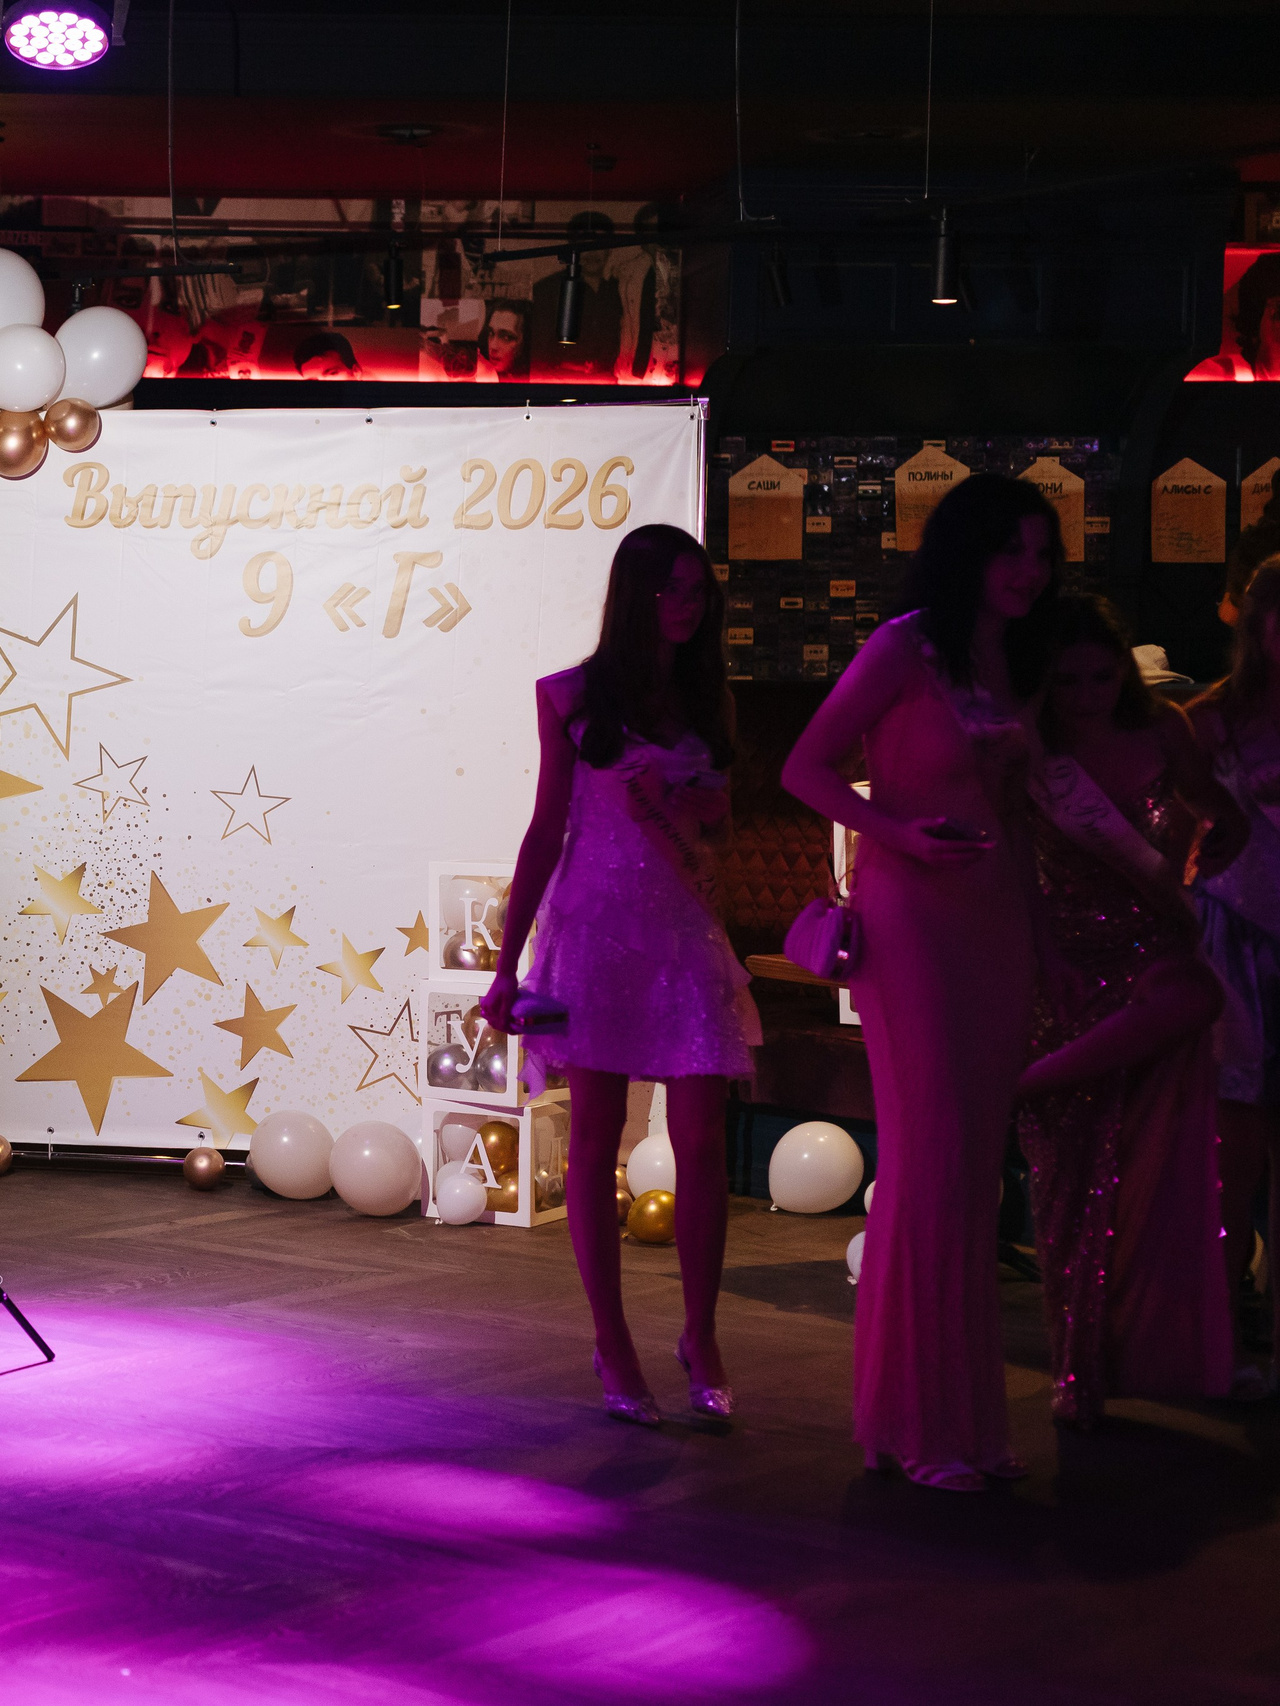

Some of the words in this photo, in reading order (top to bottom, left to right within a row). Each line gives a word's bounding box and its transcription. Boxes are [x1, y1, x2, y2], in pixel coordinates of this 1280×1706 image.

[907, 470, 953, 482] ПОЛИНЫ
[747, 480, 781, 491] САШИ
[1161, 484, 1201, 496] АЛИСЫ
[1202, 484, 1213, 495] С
[63, 461, 430, 561] Выпускной
[452, 455, 635, 531] 2026
[238, 550, 294, 638] 9
